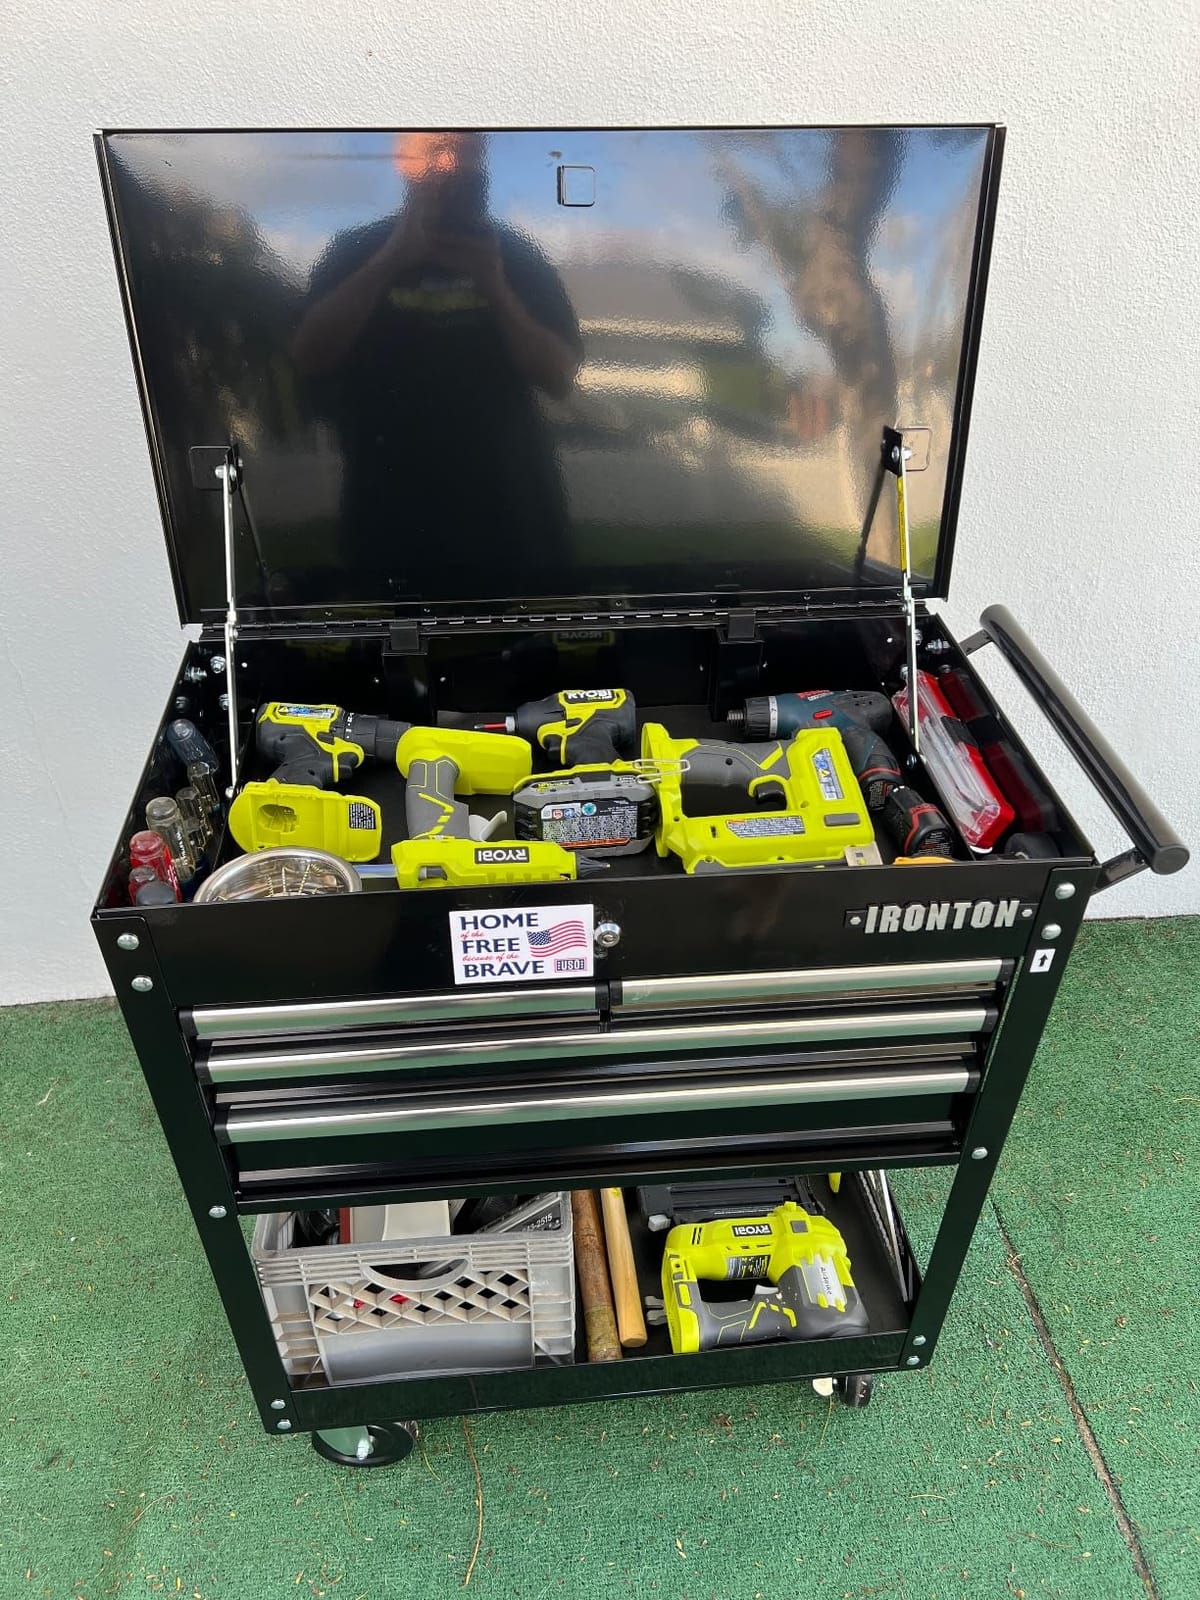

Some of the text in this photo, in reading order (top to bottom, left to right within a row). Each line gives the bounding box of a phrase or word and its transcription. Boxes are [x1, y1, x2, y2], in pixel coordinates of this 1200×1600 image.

[568, 689, 612, 699] RYOBI
[478, 849, 527, 862] RYOBI
[460, 913, 538, 931] HOME
[864, 900, 1020, 934] IRONTON
[460, 931, 470, 939] of
[462, 937, 520, 954] FREE
[462, 953, 494, 961] because
[496, 952, 505, 962] of
[463, 960, 544, 978] BRAVE
[561, 959, 580, 970] USO
[734, 1224, 771, 1235] RYOBI
